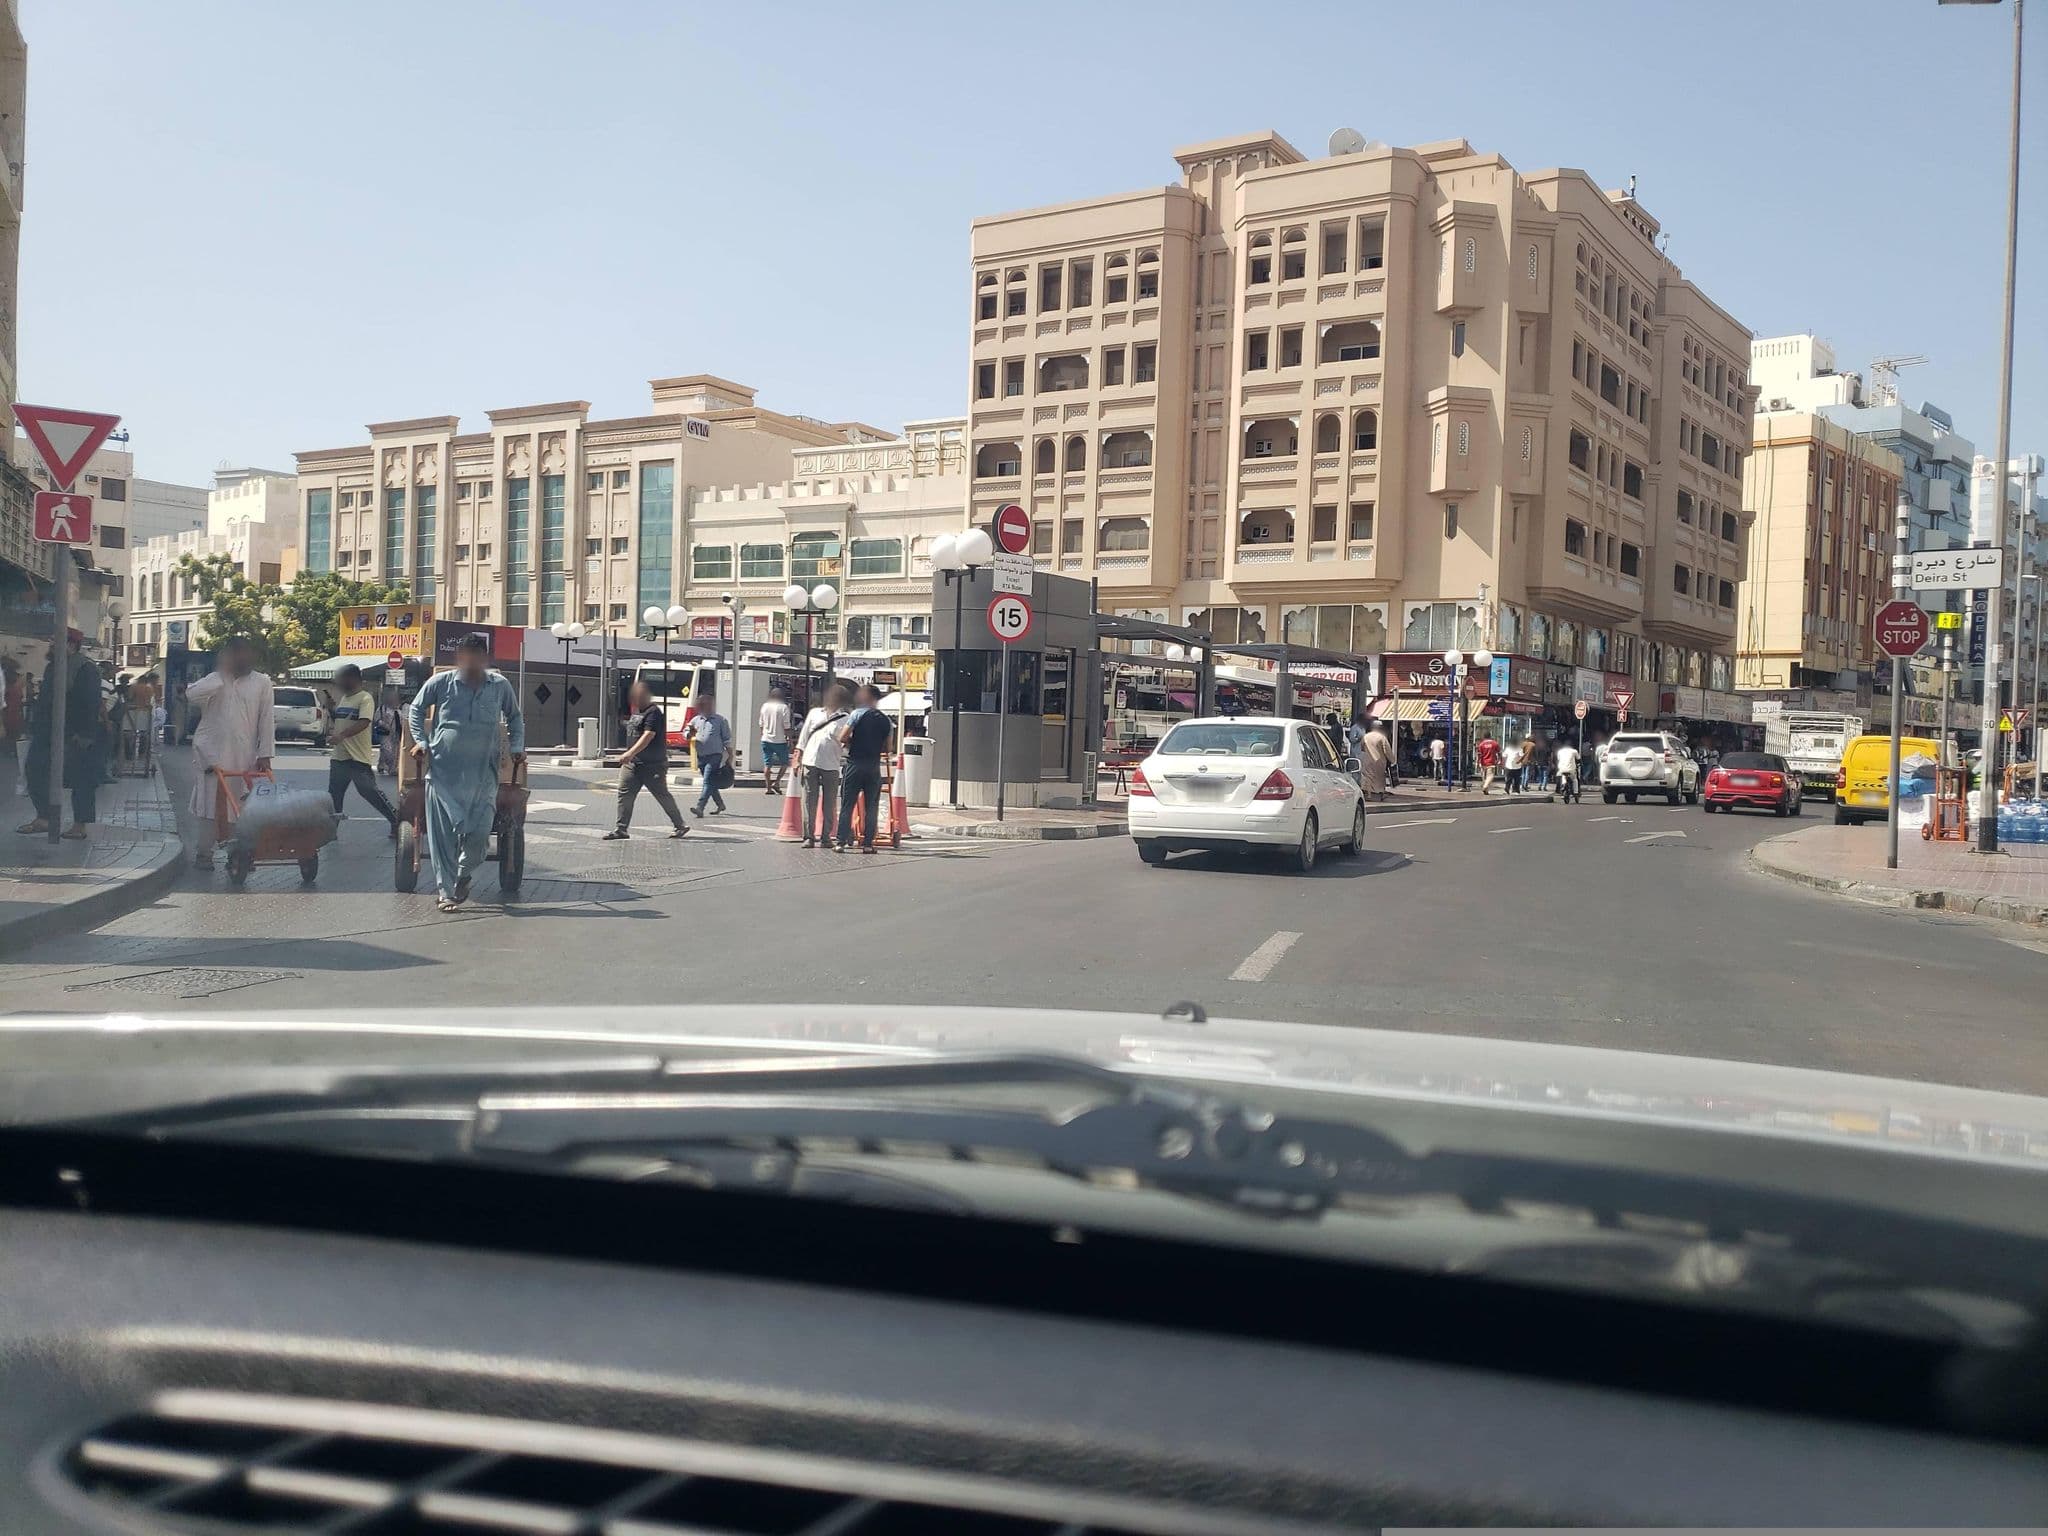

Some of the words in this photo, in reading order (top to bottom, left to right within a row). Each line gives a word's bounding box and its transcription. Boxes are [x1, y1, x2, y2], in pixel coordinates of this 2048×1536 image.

[688, 420, 709, 437] GYM
[1916, 558, 1946, 571] ديره
[1956, 555, 1997, 569] شارع
[1915, 573, 1948, 583] Deira
[1952, 572, 1967, 582] St
[998, 607, 1022, 628] 15
[1885, 607, 1919, 626] قف
[345, 634, 388, 650] ELECTRO
[390, 633, 418, 649] ZONE
[1883, 630, 1921, 644] STOP
[1409, 671, 1462, 687] SVESTON
